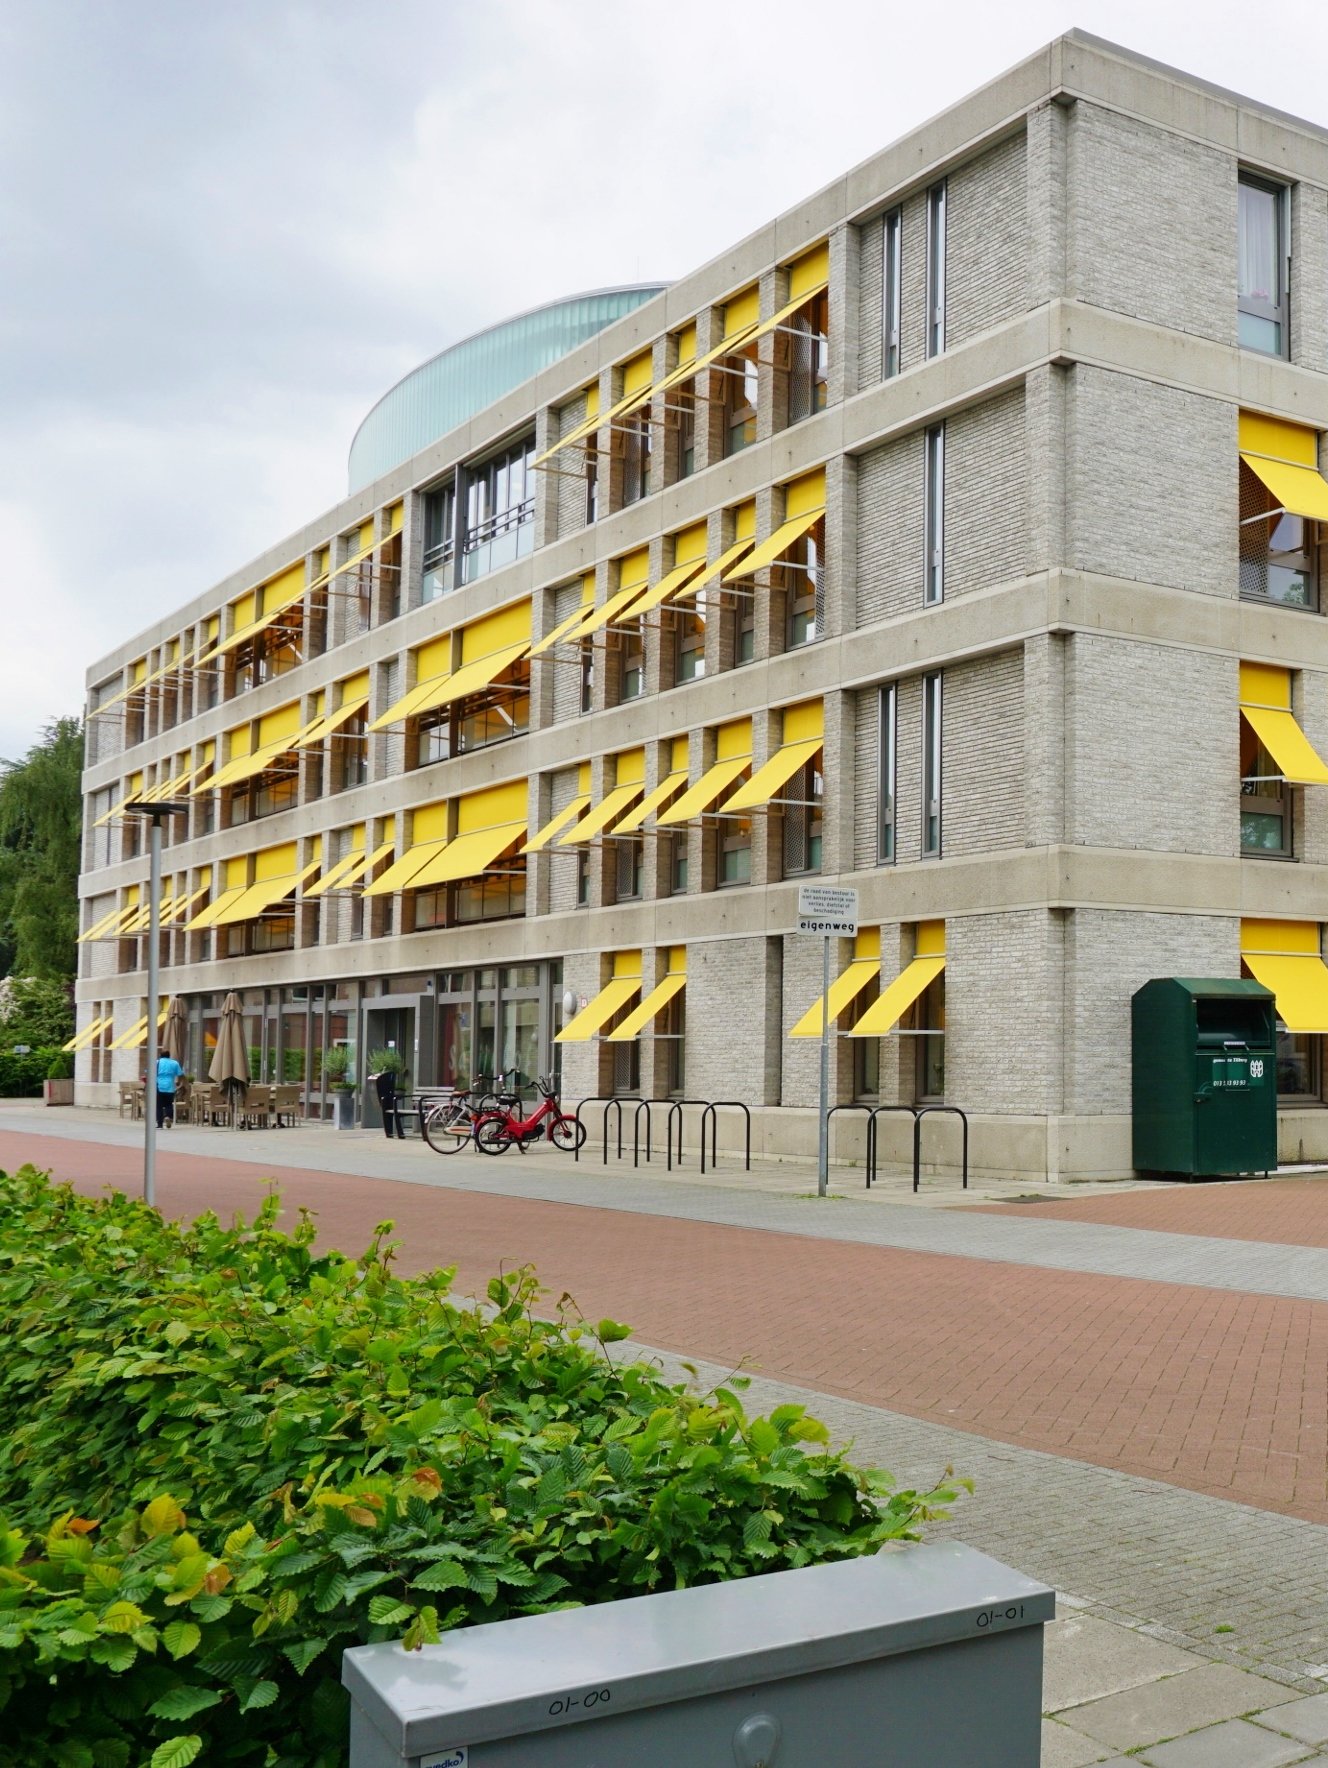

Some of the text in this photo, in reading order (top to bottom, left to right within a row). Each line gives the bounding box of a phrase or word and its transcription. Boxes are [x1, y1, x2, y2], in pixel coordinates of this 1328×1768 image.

[800, 920, 854, 933] eigenweg
[977, 1605, 1024, 1627] 01-01
[549, 1689, 610, 1715] 01-00
